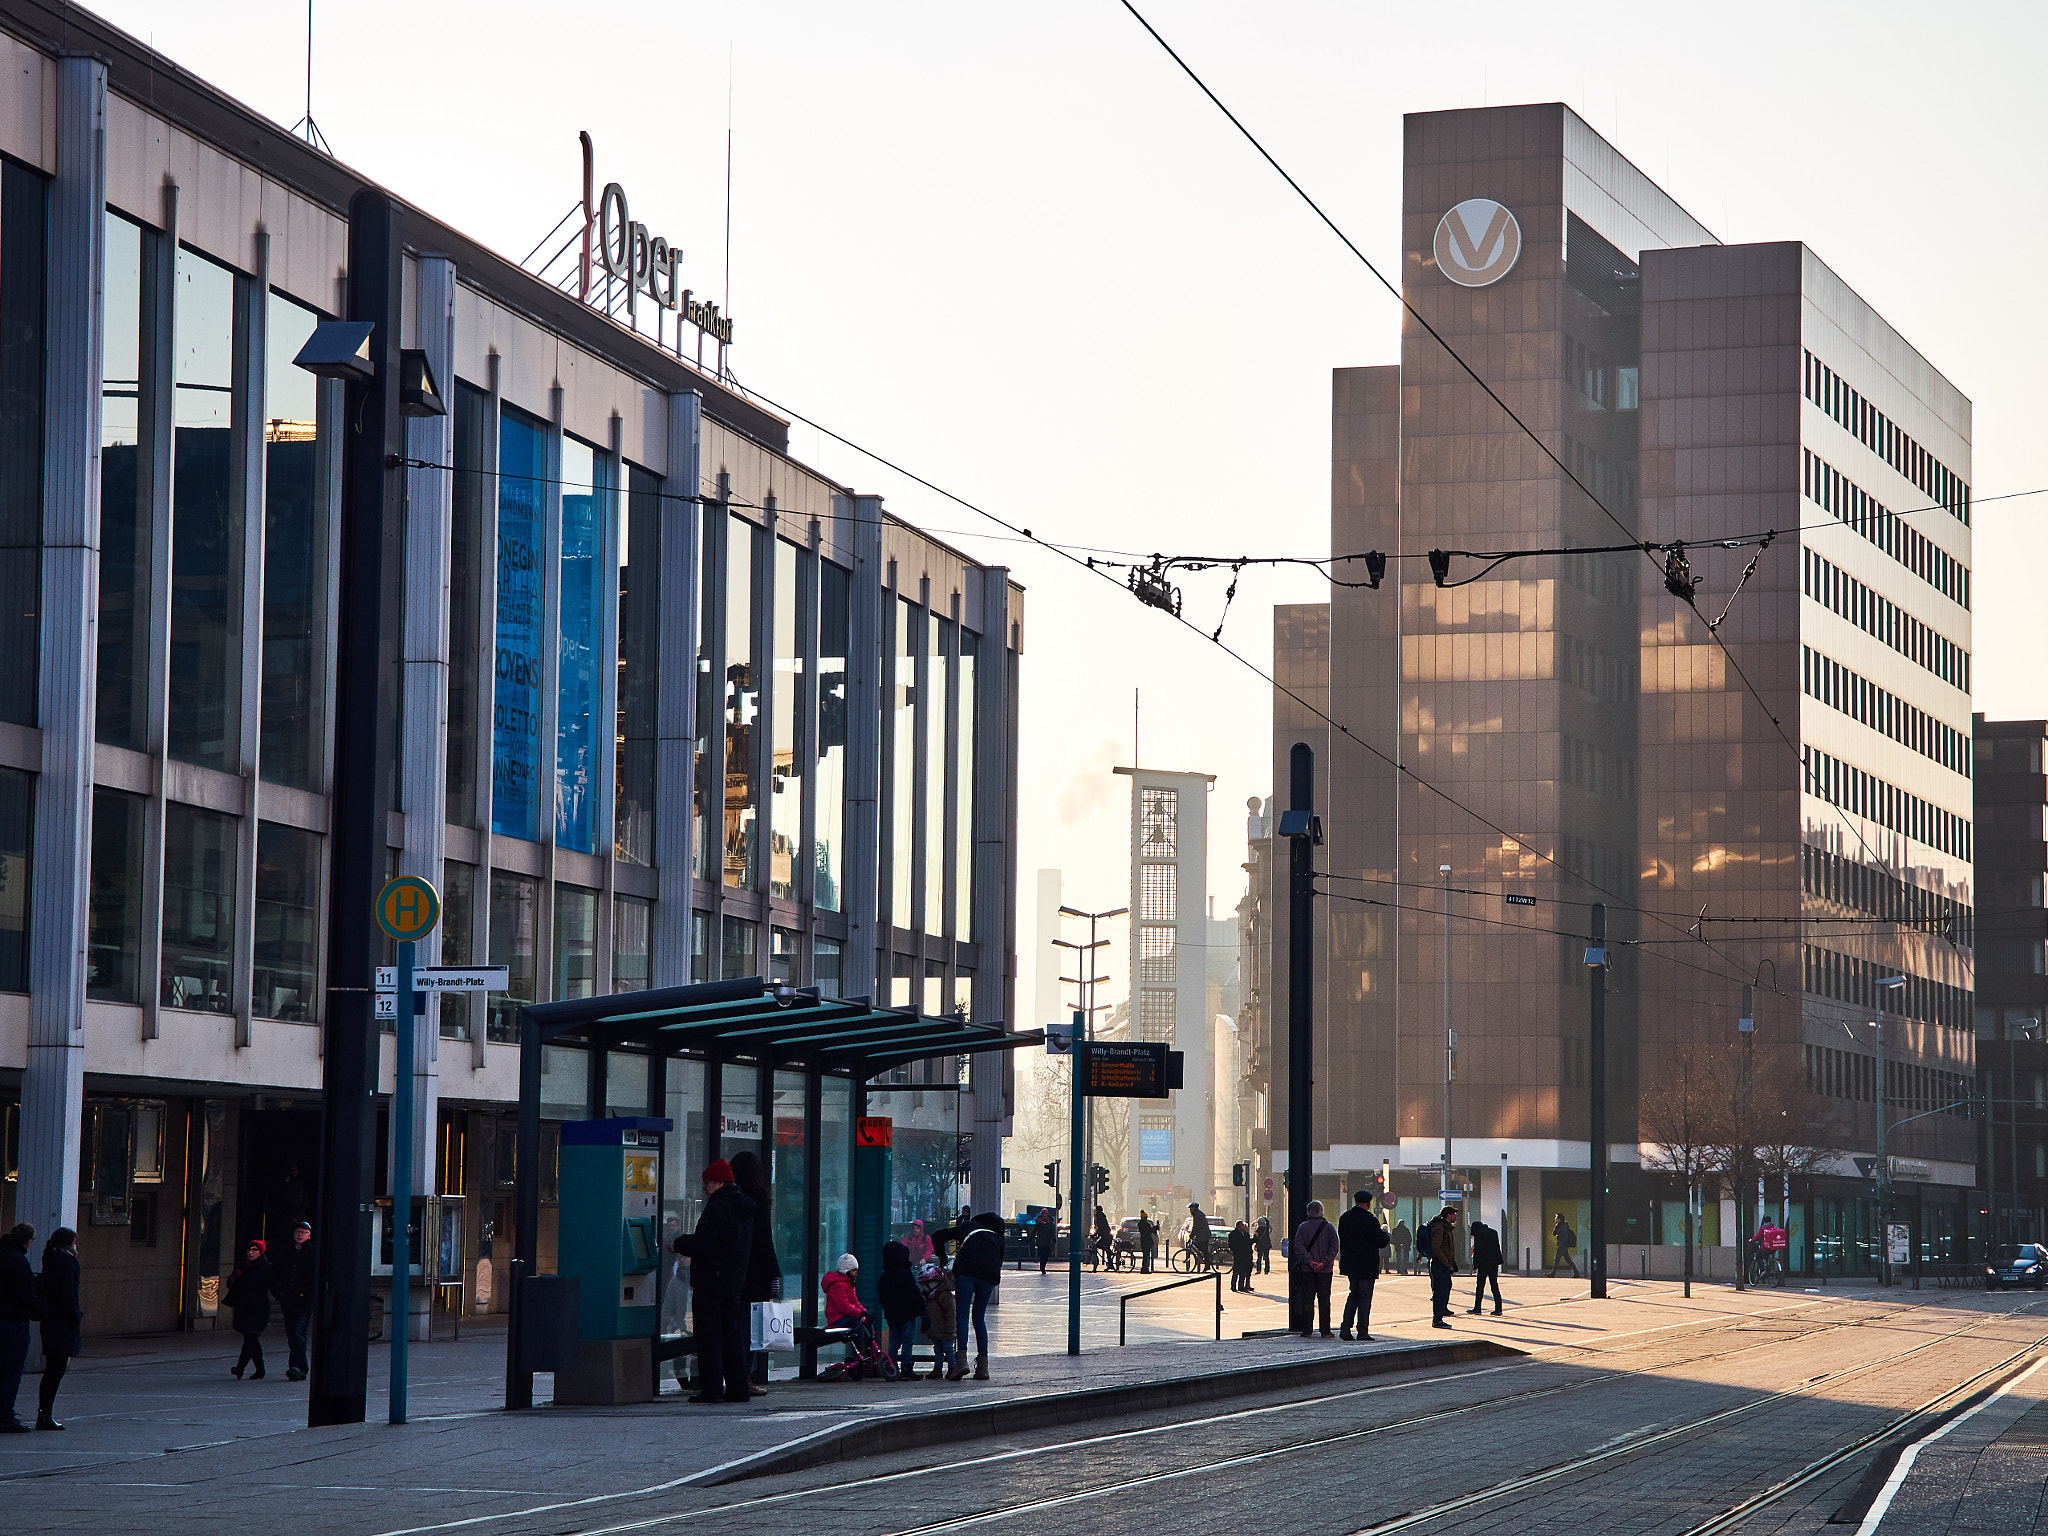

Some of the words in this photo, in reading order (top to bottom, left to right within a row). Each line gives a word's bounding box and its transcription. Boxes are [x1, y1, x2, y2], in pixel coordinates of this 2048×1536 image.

[600, 182, 683, 315] Oper
[682, 289, 734, 345] Frankfurt
[494, 704, 538, 738] OLETTO
[493, 756, 516, 785] NNE
[396, 891, 419, 926] H
[380, 972, 391, 984] 11
[416, 977, 485, 988] Willy-Brandt-Platz
[379, 1000, 392, 1011] 12
[1091, 1047, 1150, 1056] Willy-Brandt-Platz
[726, 1118, 759, 1134] Willy-Brandt-Platz
